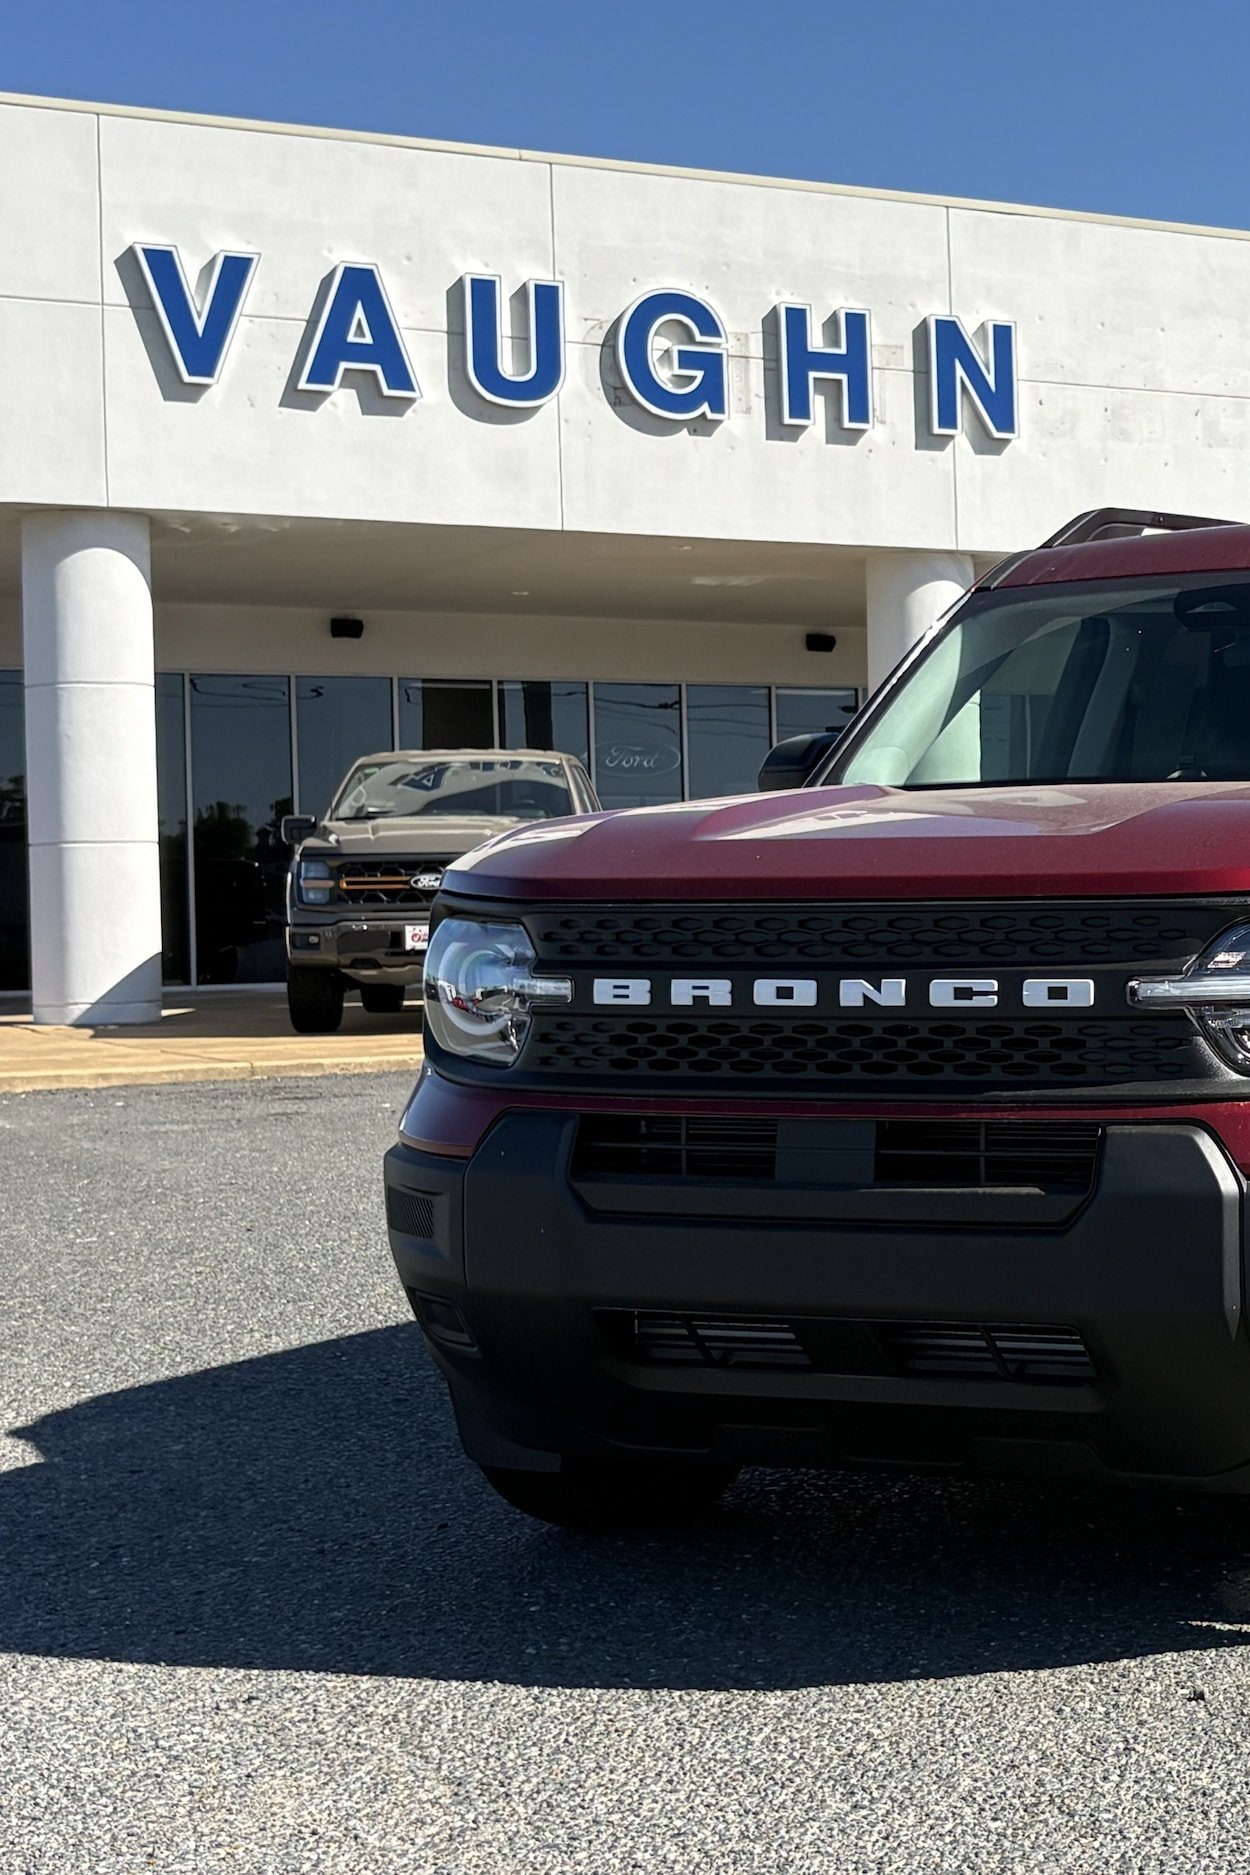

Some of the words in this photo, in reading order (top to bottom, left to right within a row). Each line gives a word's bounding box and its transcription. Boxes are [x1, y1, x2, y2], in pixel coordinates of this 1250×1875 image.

[130, 241, 1020, 441] VAUGHN
[606, 745, 659, 768] Ford
[593, 979, 1095, 1007] BRONCO
